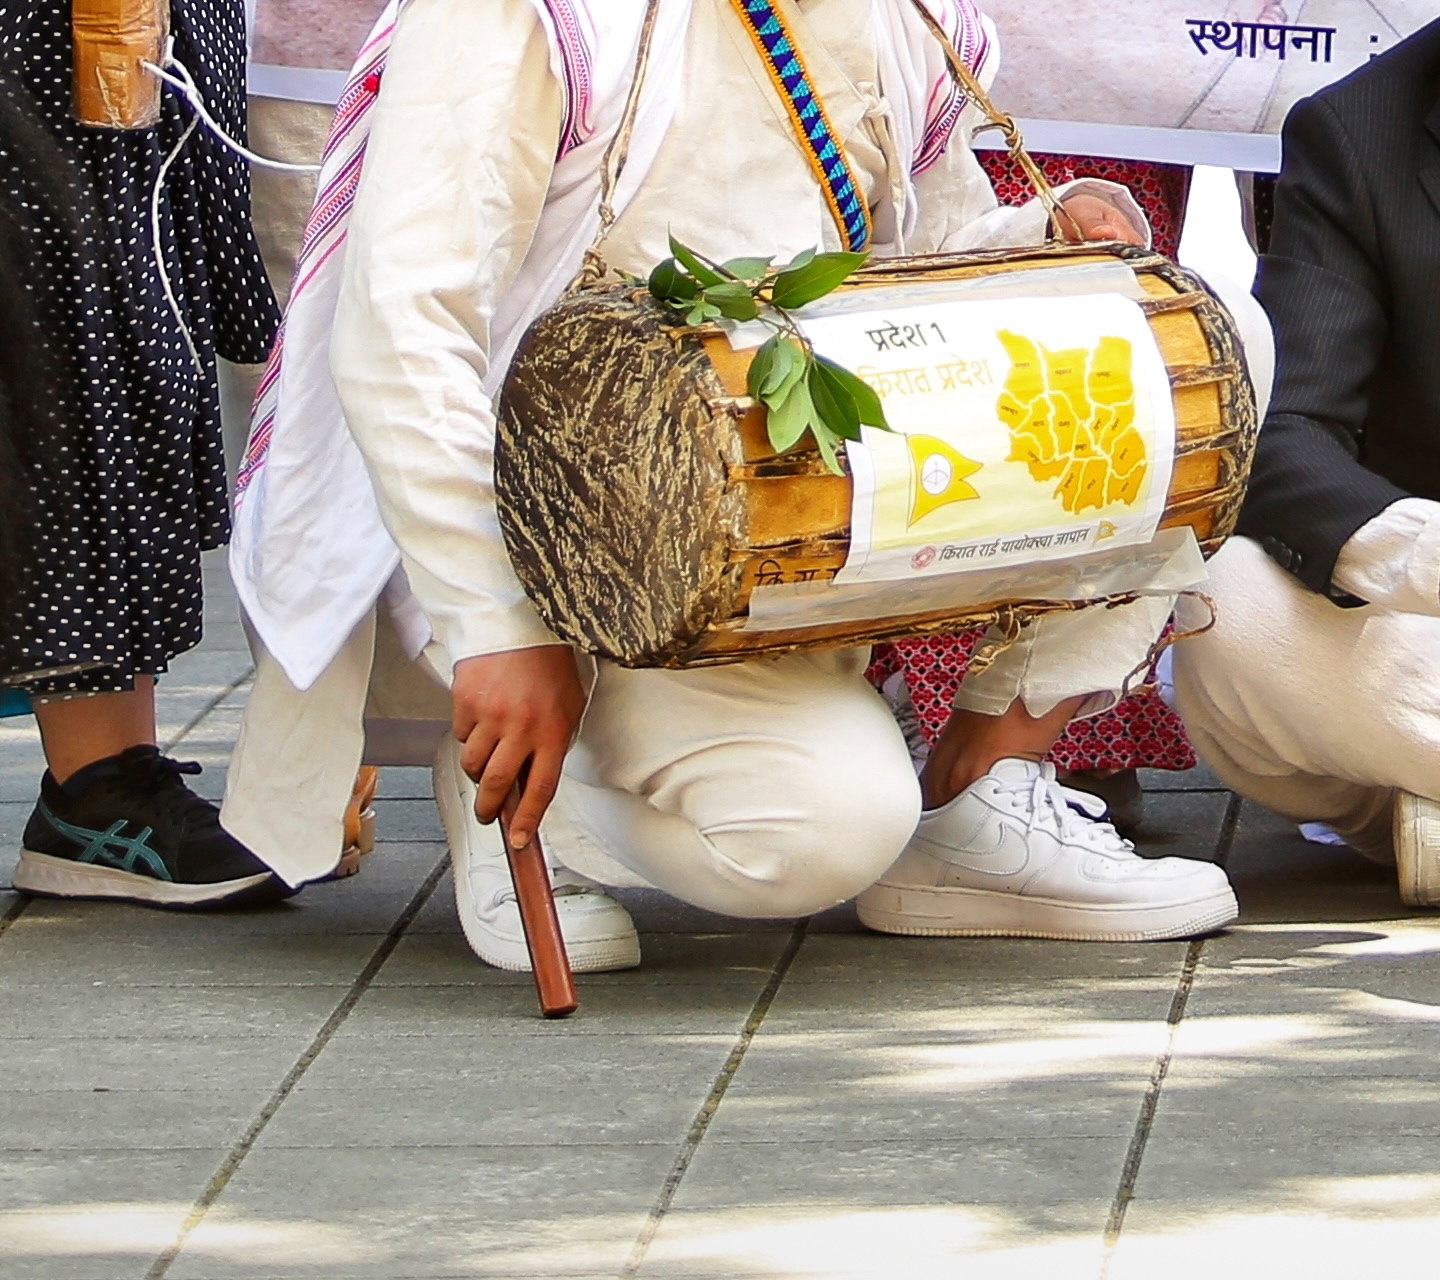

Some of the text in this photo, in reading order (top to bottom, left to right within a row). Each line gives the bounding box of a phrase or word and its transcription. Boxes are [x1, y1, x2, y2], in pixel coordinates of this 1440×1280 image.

[1185, 18, 1337, 63] स्थापना
[865, 319, 928, 352] प्रदेश
[934, 354, 994, 391] प्रदेश
[938, 545, 978, 562] किरात
[979, 538, 1000, 557] राई
[1054, 528, 1091, 547] जापान
